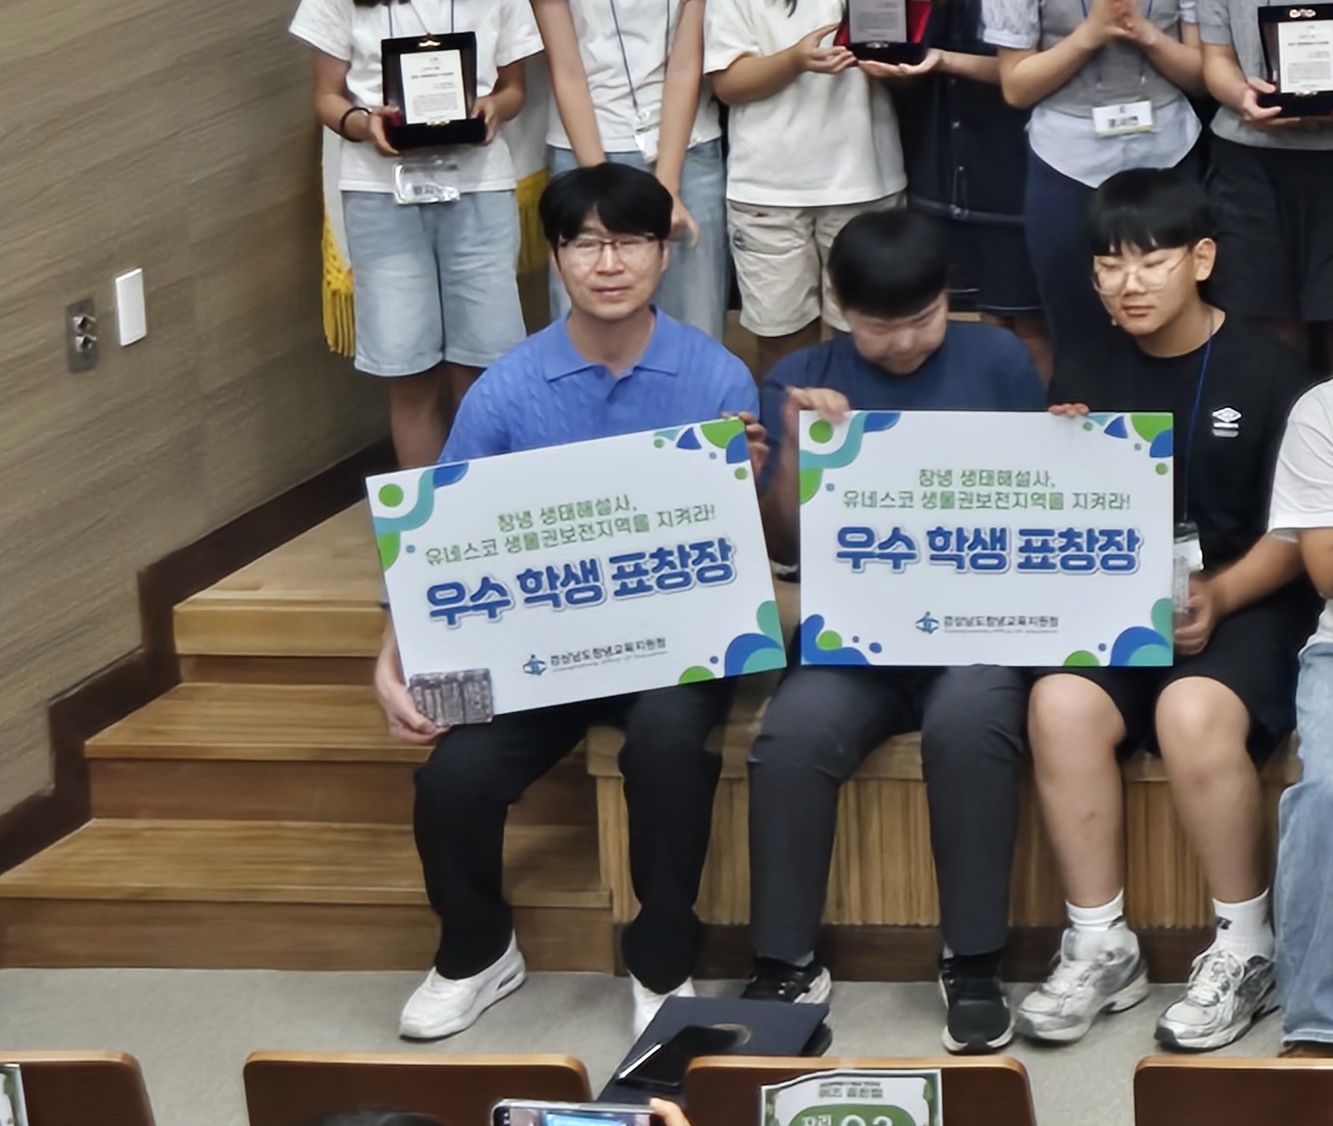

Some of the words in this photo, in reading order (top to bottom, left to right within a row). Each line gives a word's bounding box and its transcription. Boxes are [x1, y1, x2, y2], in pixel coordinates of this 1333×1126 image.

[919, 469, 953, 488] 창녕
[843, 491, 914, 509] 유네스코
[497, 508, 533, 533] 창녕
[425, 538, 498, 566] 유네스코
[836, 526, 918, 570] 우수
[927, 526, 1007, 570] 학생
[1017, 527, 1140, 571] 표창장
[426, 577, 512, 626] 우수
[517, 558, 603, 608] 학생
[609, 537, 736, 597] 표창장
